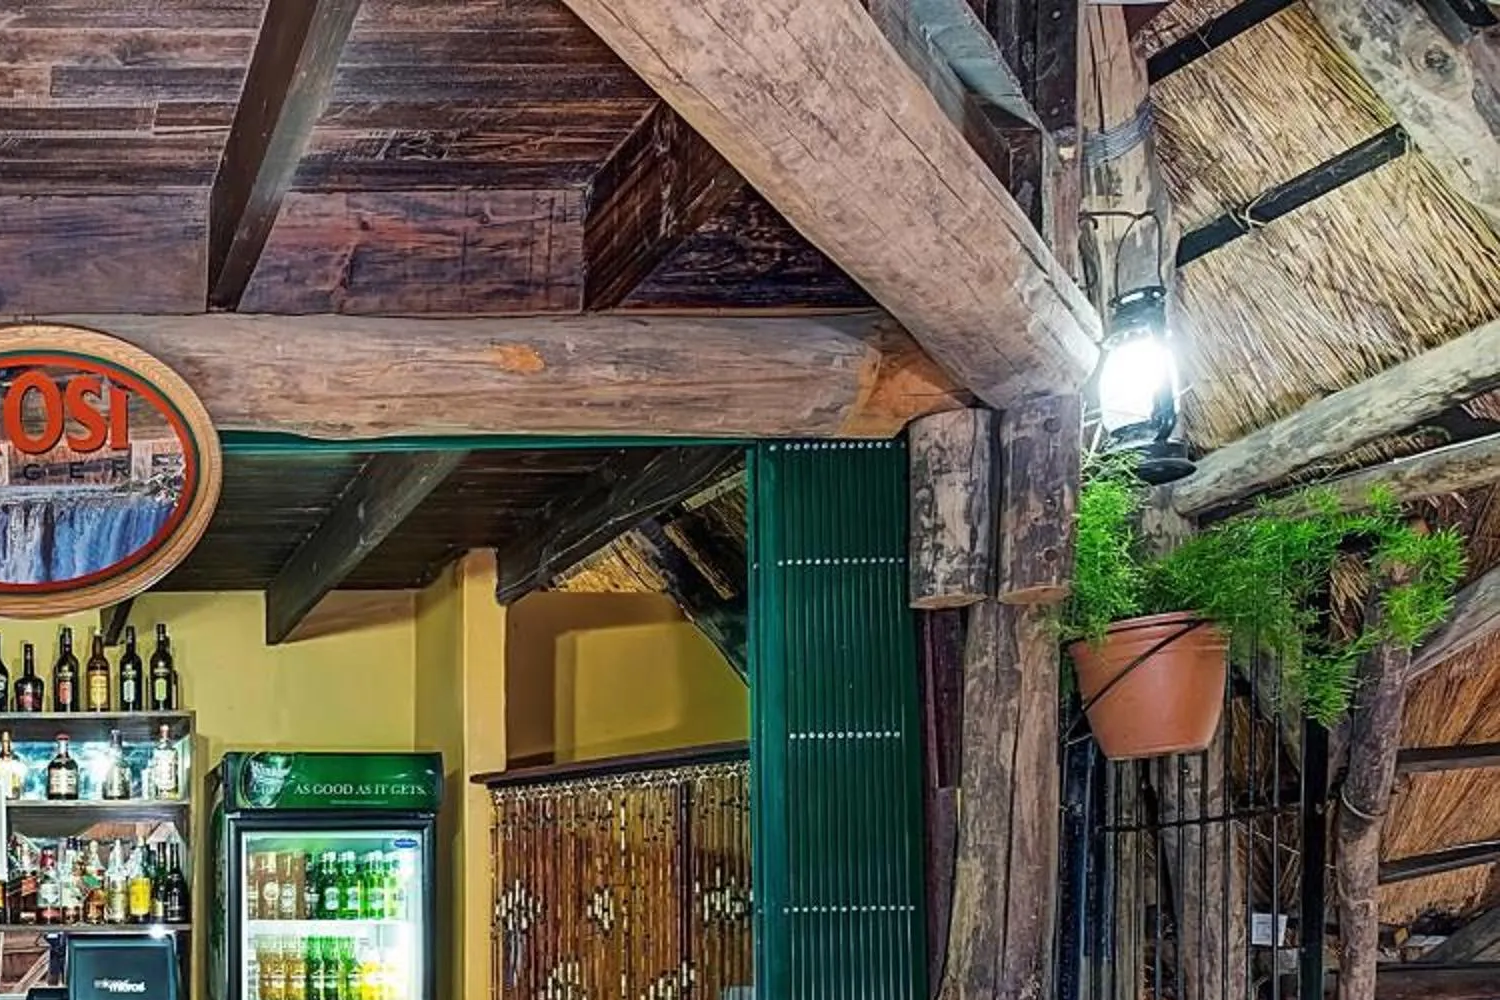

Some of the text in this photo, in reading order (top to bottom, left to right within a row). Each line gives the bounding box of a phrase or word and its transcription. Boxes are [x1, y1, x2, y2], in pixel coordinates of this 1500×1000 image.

[293, 784, 311, 795] AS
[313, 783, 353, 795] GOOD
[356, 784, 373, 795] AS
[374, 784, 388, 795] IT
